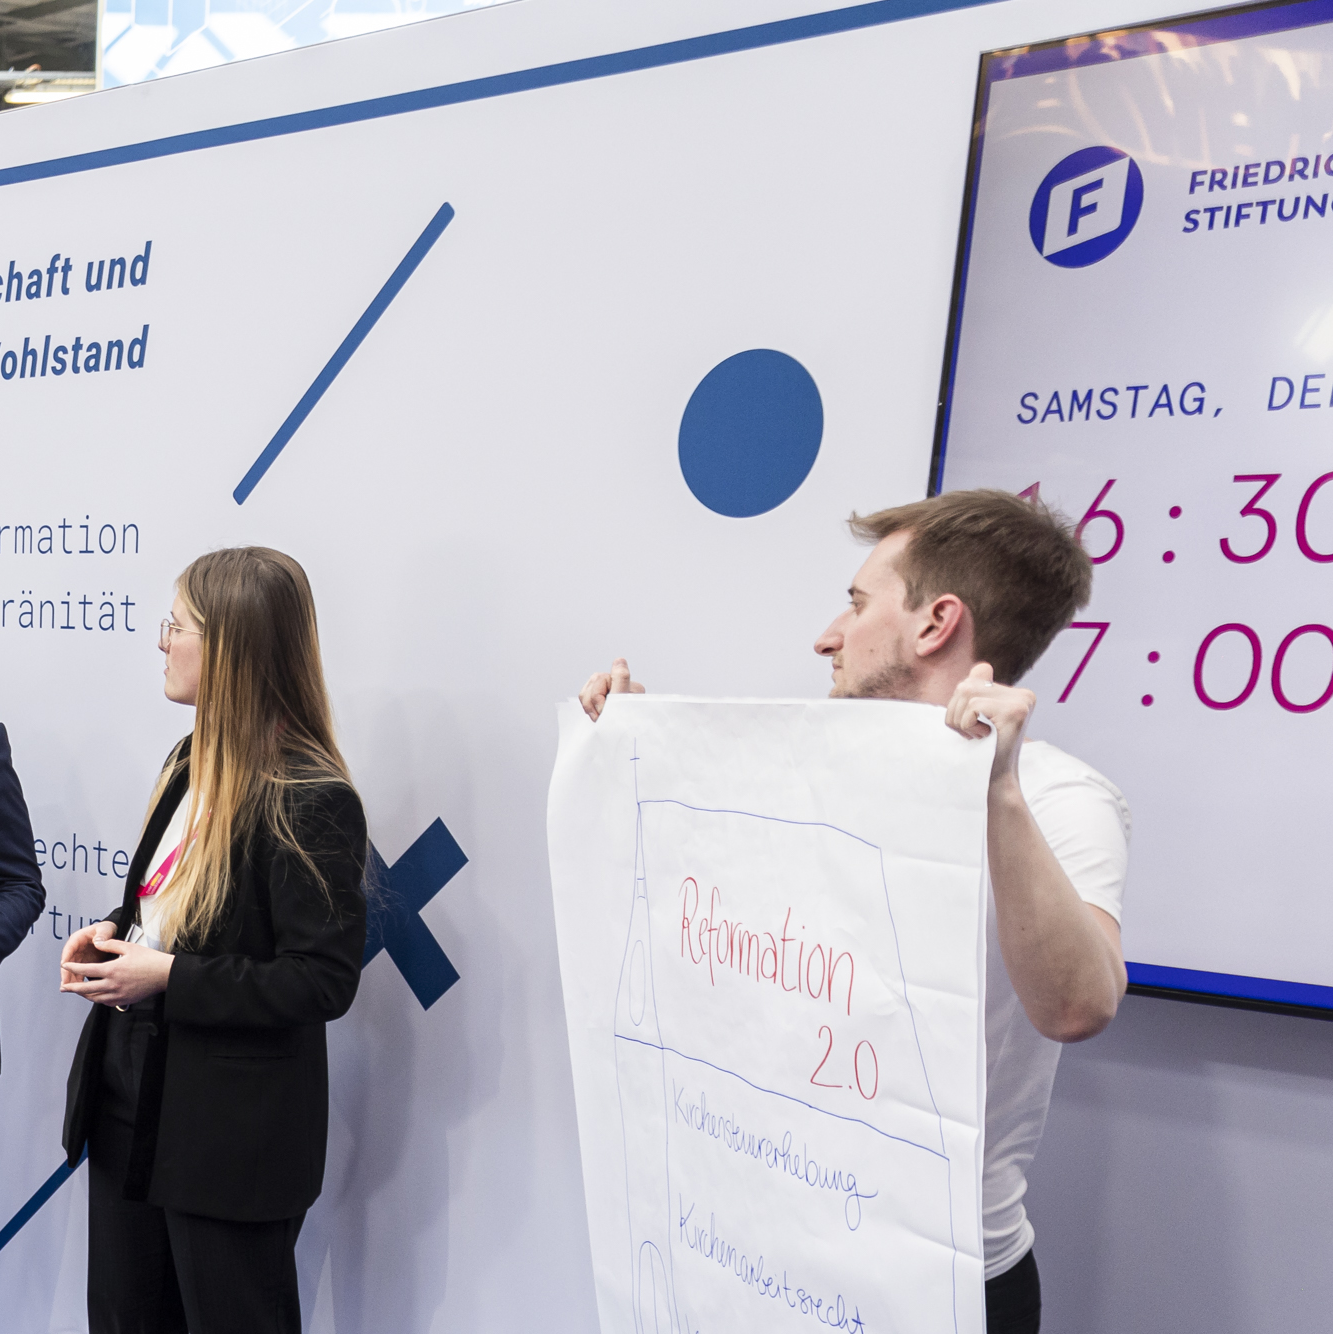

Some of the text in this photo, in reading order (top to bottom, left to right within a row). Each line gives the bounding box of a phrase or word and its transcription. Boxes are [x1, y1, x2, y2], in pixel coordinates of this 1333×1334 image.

[1067, 177, 1104, 237] F
[1182, 193, 1333, 233] STIFTUN
[84, 240, 152, 292] und
[1017, 373, 1333, 425] SAMSTAG, DE
[1016, 471, 1333, 565] 6:30
[678, 876, 855, 1016] Reformation
[810, 1025, 879, 1100] 2.0
